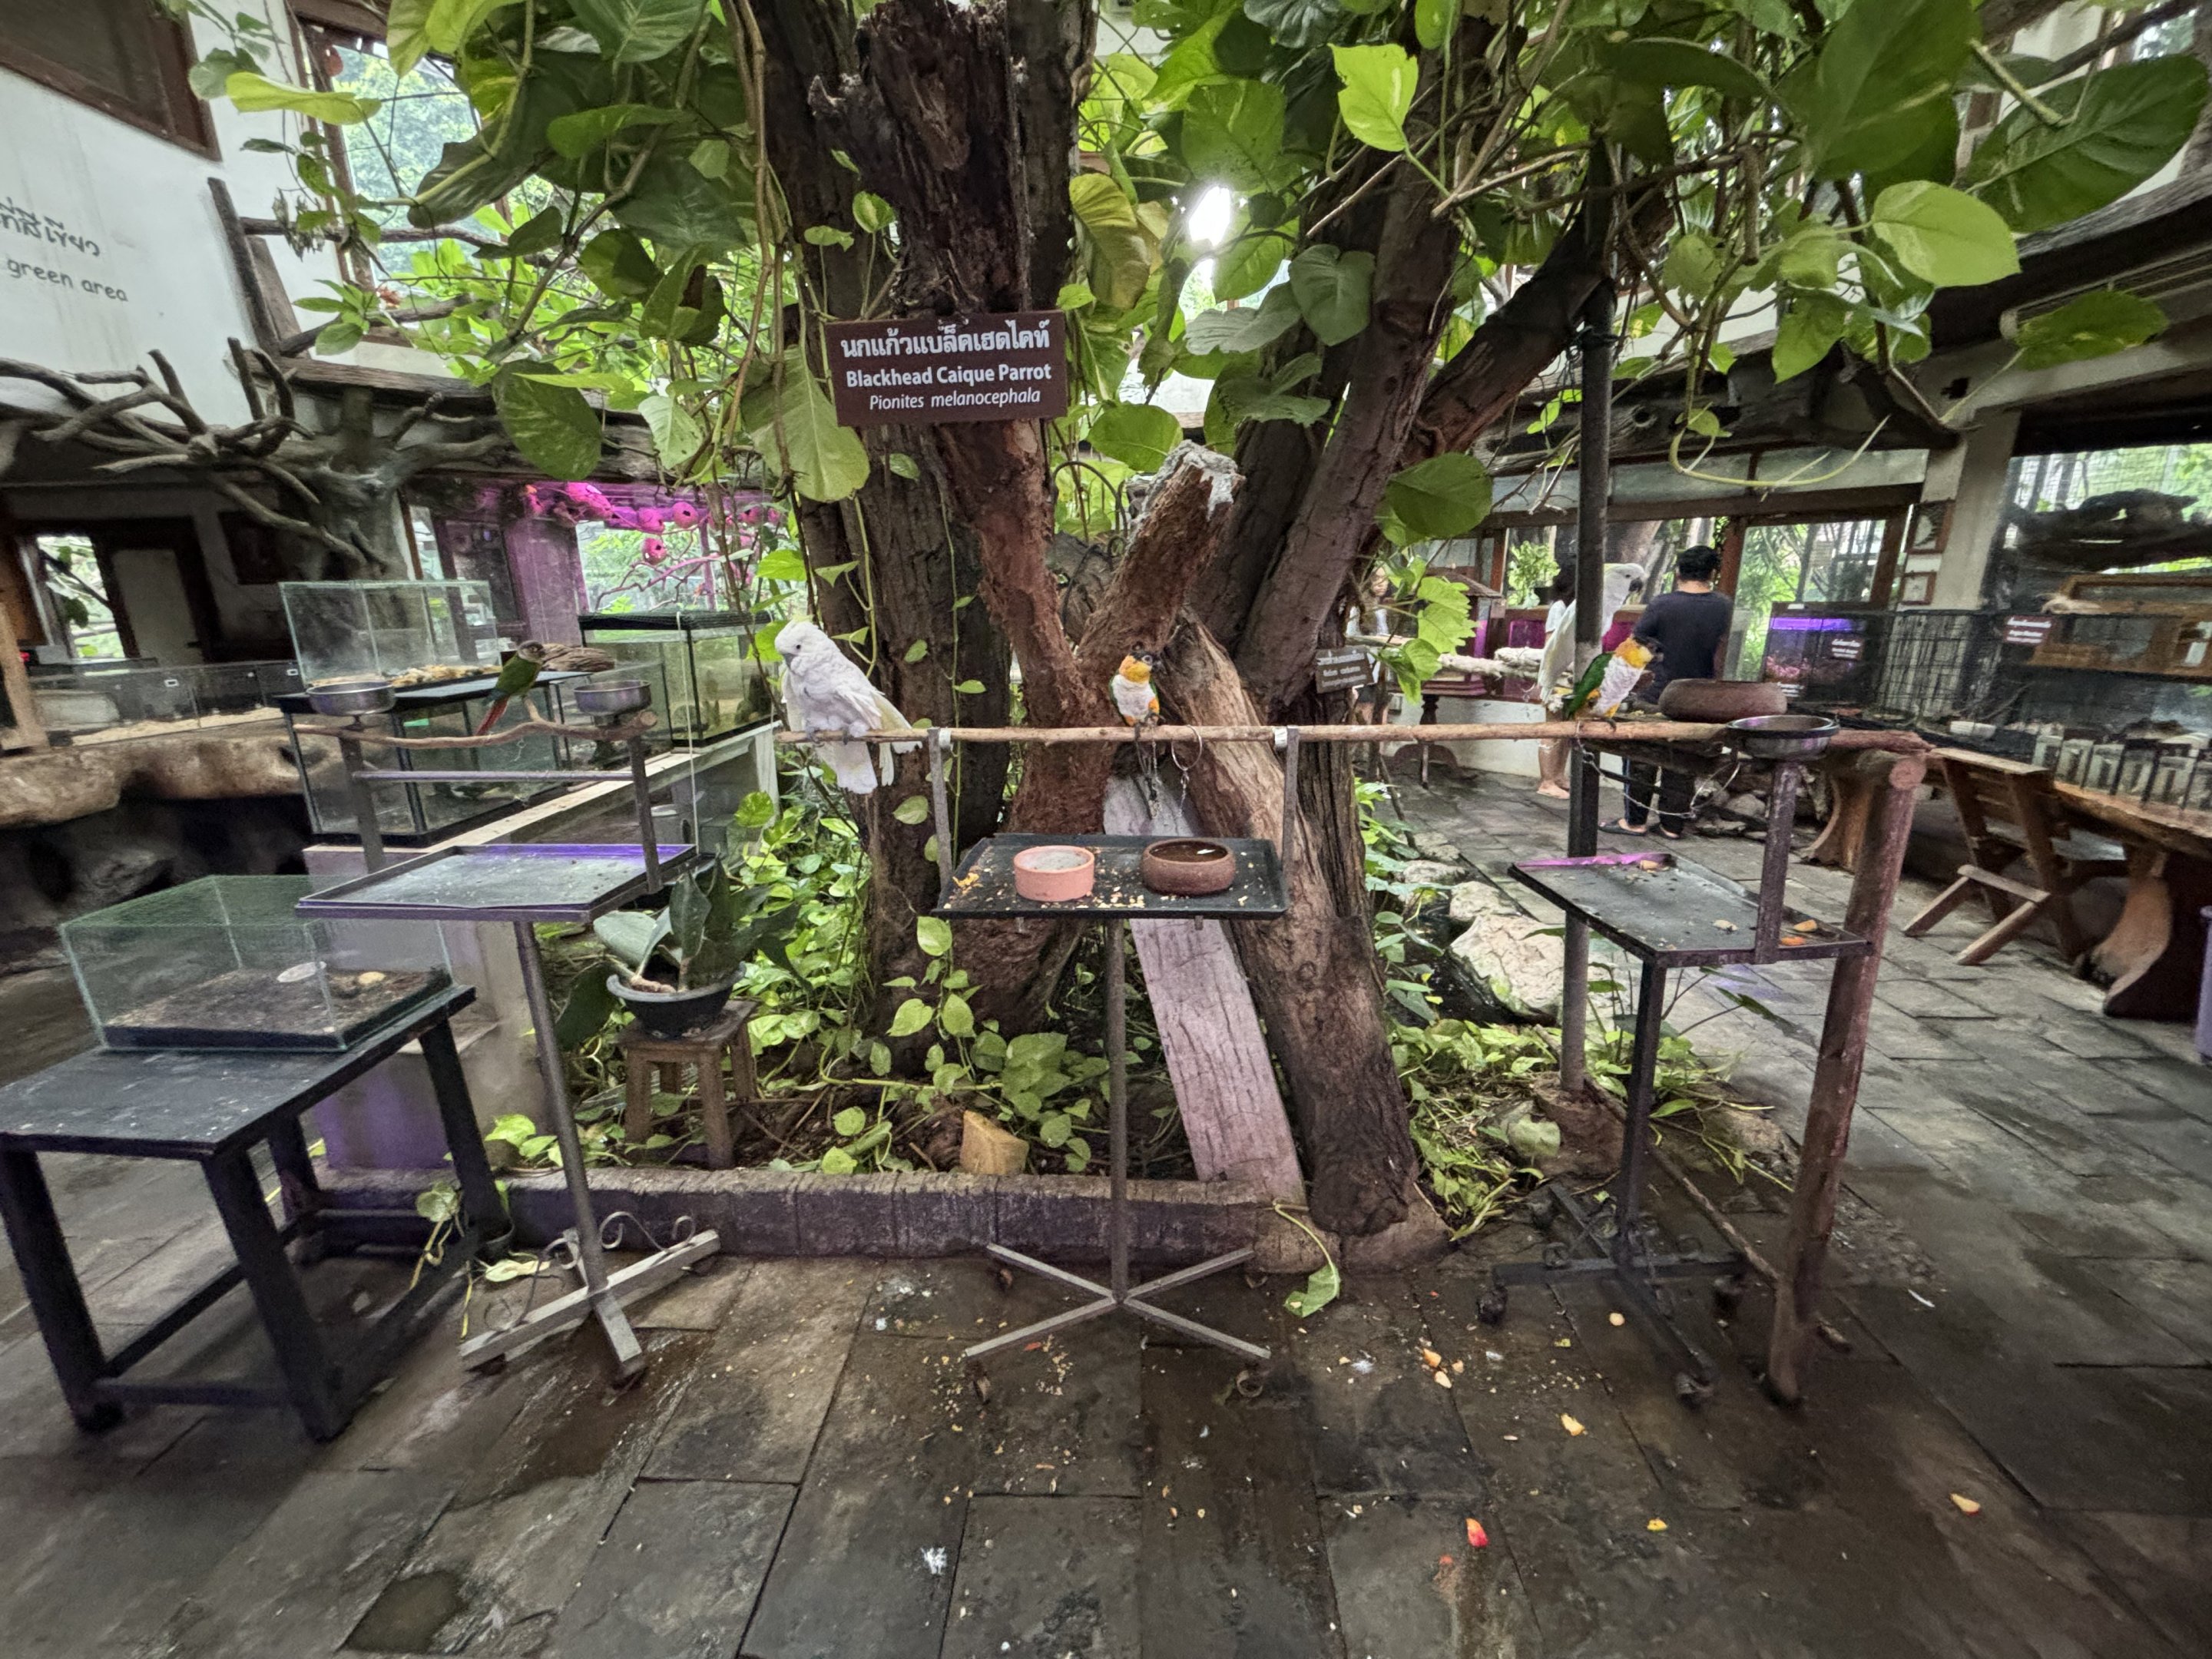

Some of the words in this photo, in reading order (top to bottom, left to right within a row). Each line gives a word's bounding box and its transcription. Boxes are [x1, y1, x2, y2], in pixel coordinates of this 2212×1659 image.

[7, 259, 74, 289] green
[81, 279, 128, 302] area
[846, 366, 932, 387] Blackhead
[936, 366, 995, 386] Caique
[998, 363, 1051, 381] Parrot
[869, 393, 925, 410] Pionites
[931, 386, 1041, 408] melanocephala
